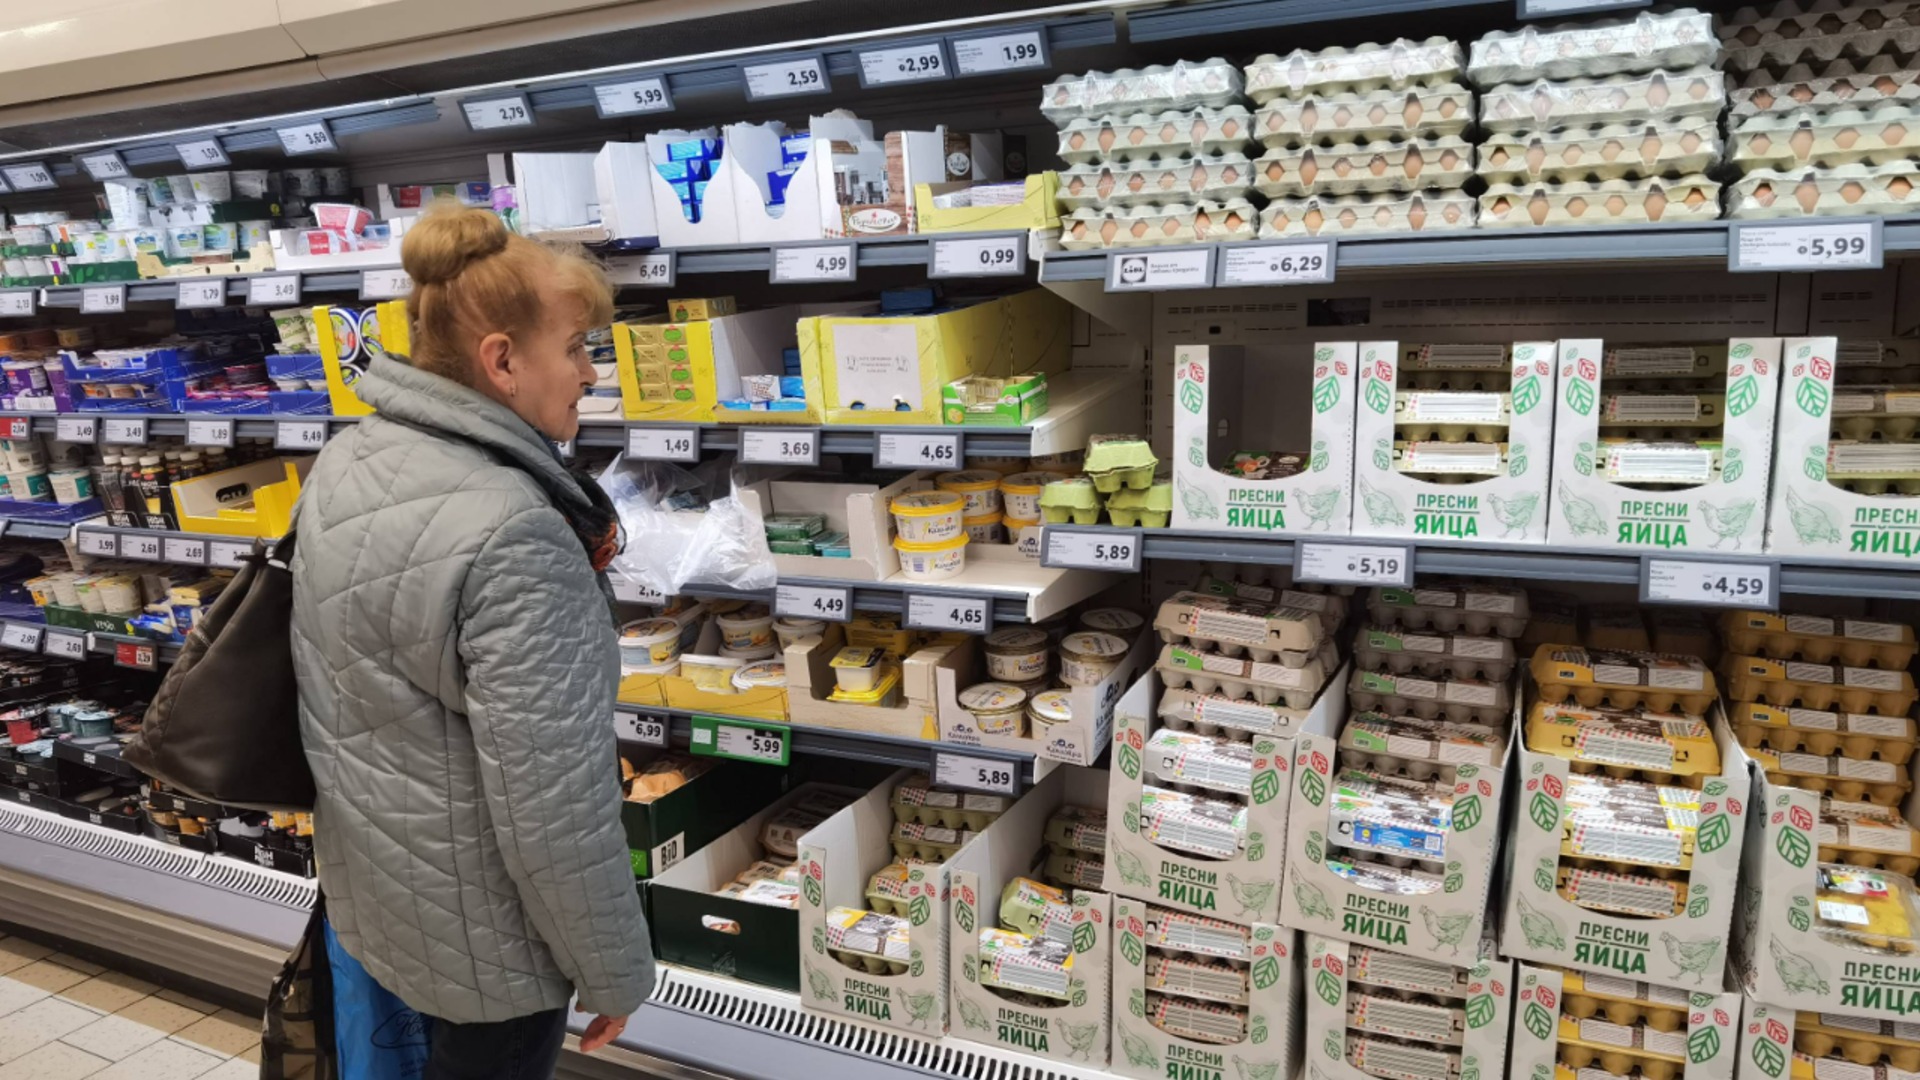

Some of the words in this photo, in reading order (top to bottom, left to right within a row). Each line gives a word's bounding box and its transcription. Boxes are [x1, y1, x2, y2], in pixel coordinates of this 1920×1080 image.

[1003, 43, 1037, 62] 1,99
[907, 55, 940, 74] 2,99
[788, 69, 819, 86] 2,59
[634, 89, 663, 106] 5,99
[499, 106, 524, 121] 2,79
[305, 131, 327, 145] 3,69
[1811, 236, 1865, 258] 5,99
[816, 256, 848, 274] 4,99
[980, 249, 1015, 267] 0,99
[1280, 255, 1322, 275] 6,29
[639, 264, 667, 281] 6,49
[203, 288, 219, 300] 1,79
[275, 284, 294, 297] 3,49
[104, 294, 120, 306] 1,99
[302, 430, 322, 443] 6,49
[664, 436, 691, 454] 1,49
[780, 439, 811, 458] 3,69
[920, 442, 954, 462] 4,65
[1229, 487, 1285, 503] ПРЕСНИ
[1416, 493, 1478, 509] ПРЕСНИ
[1226, 503, 1286, 530] ЯЙЦА
[1621, 500, 1689, 517] ПРЕСНИ
[1854, 507, 1920, 525] ПРЕСН
[1413, 510, 1478, 539] ЯЙЦА
[1617, 517, 1688, 549] ЯЙЦА
[141, 543, 157, 554] 2,69
[186, 547, 203, 558] 2,69
[1095, 544, 1130, 561] 5,89
[1360, 557, 1399, 576] 5,19
[1714, 576, 1764, 597] 4,59
[813, 598, 844, 613] 4,49
[950, 608, 982, 626] 4,65
[20, 633, 36, 645] 2,99
[66, 642, 82, 653] 2,69
[635, 722, 661, 738] 6,99
[752, 739, 780, 754] 5,99
[978, 768, 1010, 786] 5,89
[1160, 861, 1218, 886] ПРЕСНИ
[1158, 880, 1217, 911] ЯЙЦА
[1346, 893, 1410, 919] ПРЕСНИ
[1341, 912, 1408, 946] ЯЙЦА
[1579, 921, 1650, 947] ПРЕСНИ
[1573, 939, 1647, 975] ЯЙЦА
[1844, 961, 1920, 983] ПРЕСНИ
[844, 977, 891, 998] ПРЕСНИ
[844, 993, 892, 1021] ЯЙЦА
[998, 1008, 1049, 1030] ПРЕСНИ
[997, 1023, 1049, 1052] ЯЙЦА
[1167, 1043, 1223, 1067] ПРЕСНИ
